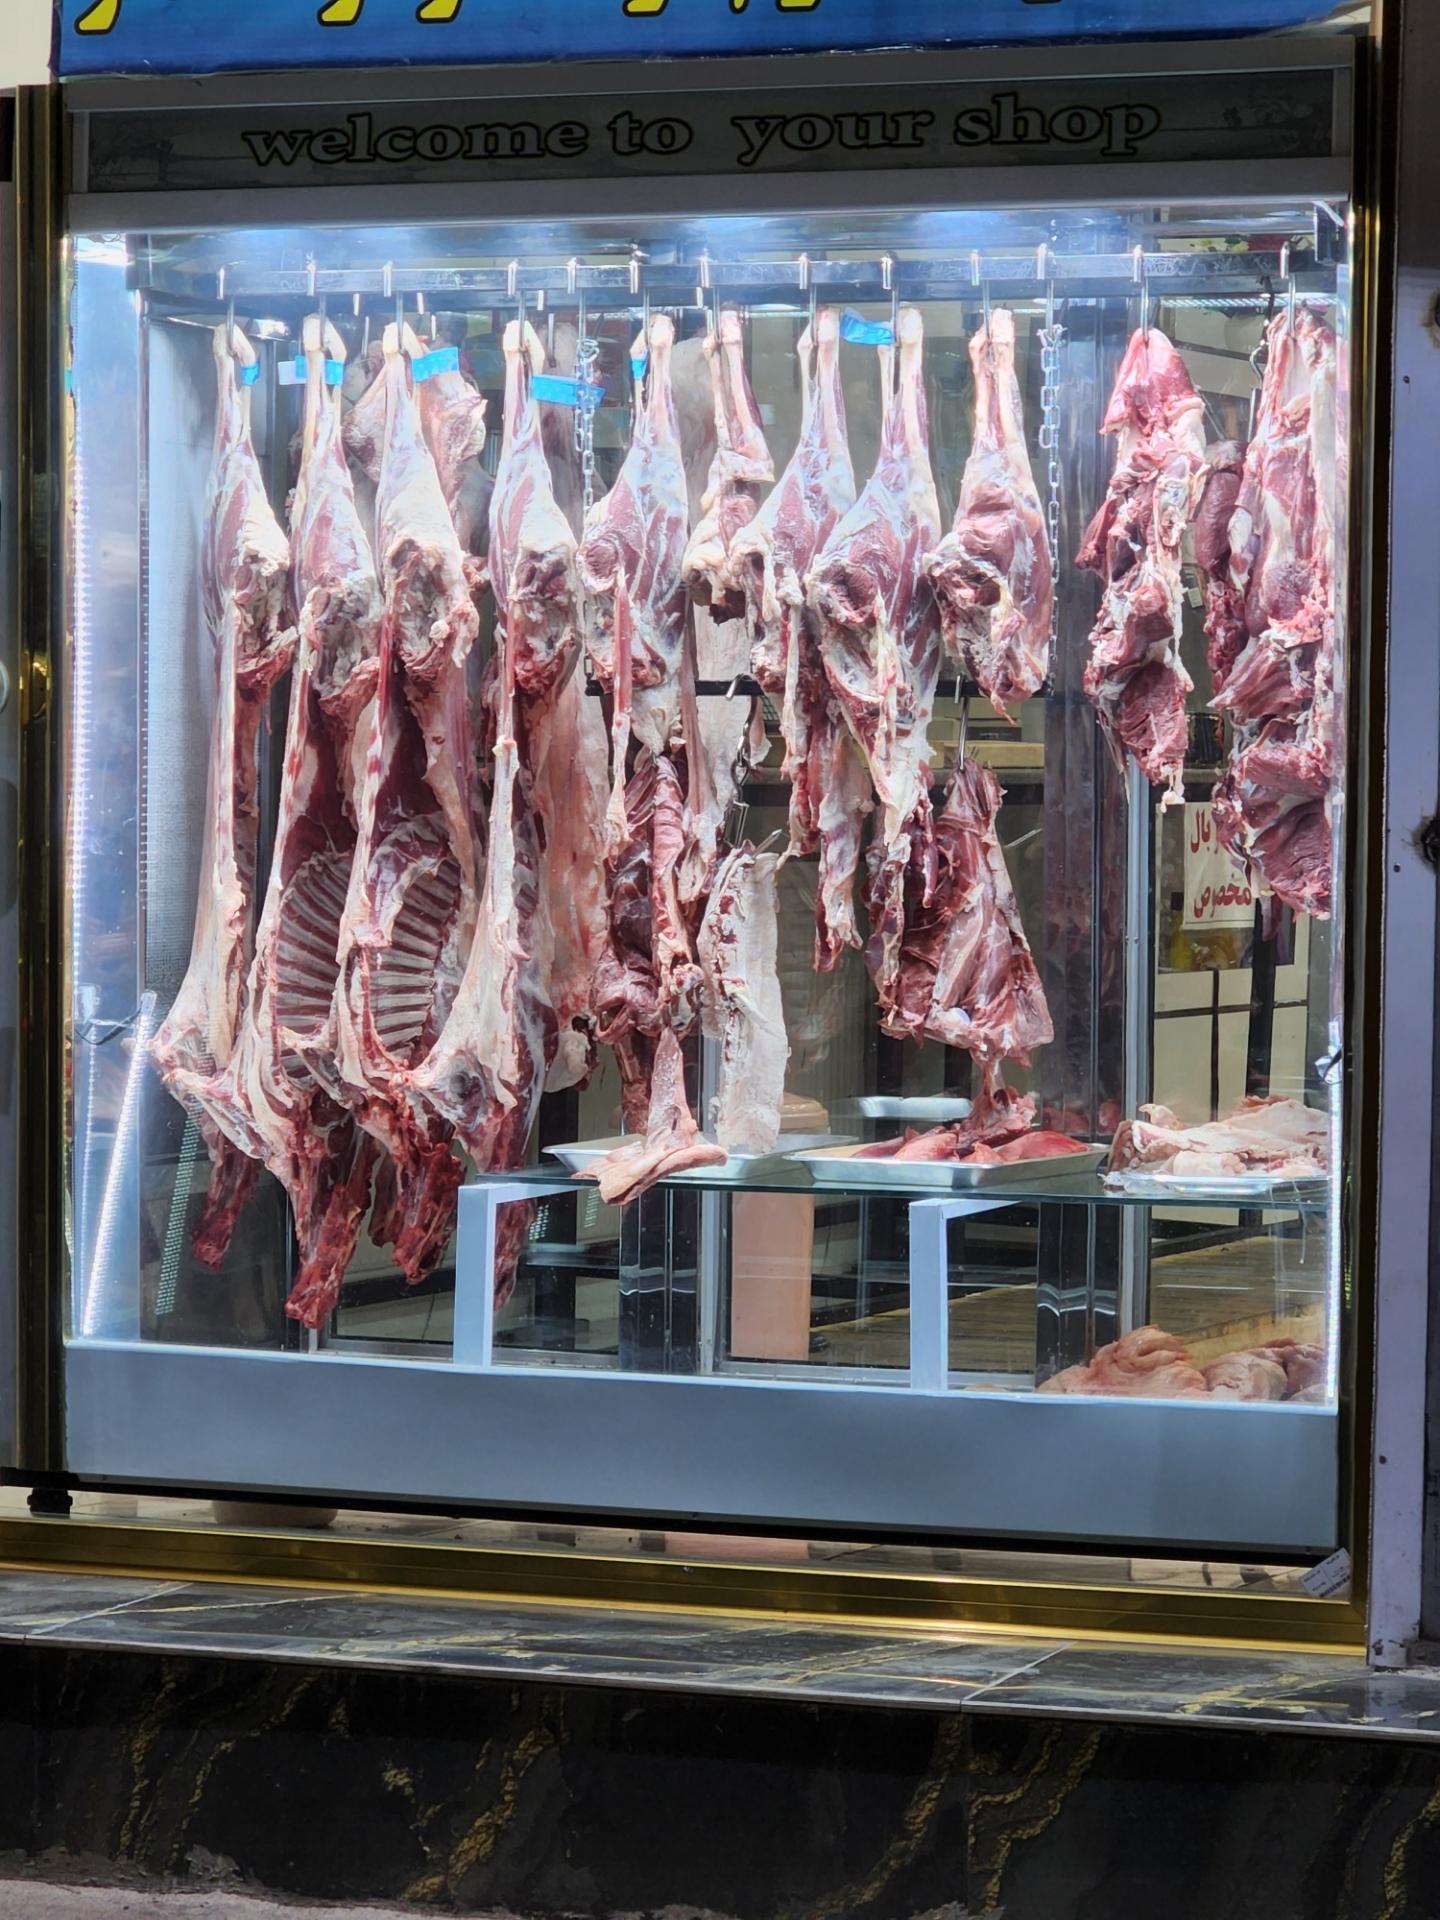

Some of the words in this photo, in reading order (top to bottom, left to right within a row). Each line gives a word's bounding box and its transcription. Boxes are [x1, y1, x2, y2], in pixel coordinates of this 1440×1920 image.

[241, 111, 590, 167] welcome
[606, 109, 693, 156] to
[730, 110, 936, 167] your
[953, 92, 1162, 156] shop
[1193, 873, 1252, 919] مخصوص
